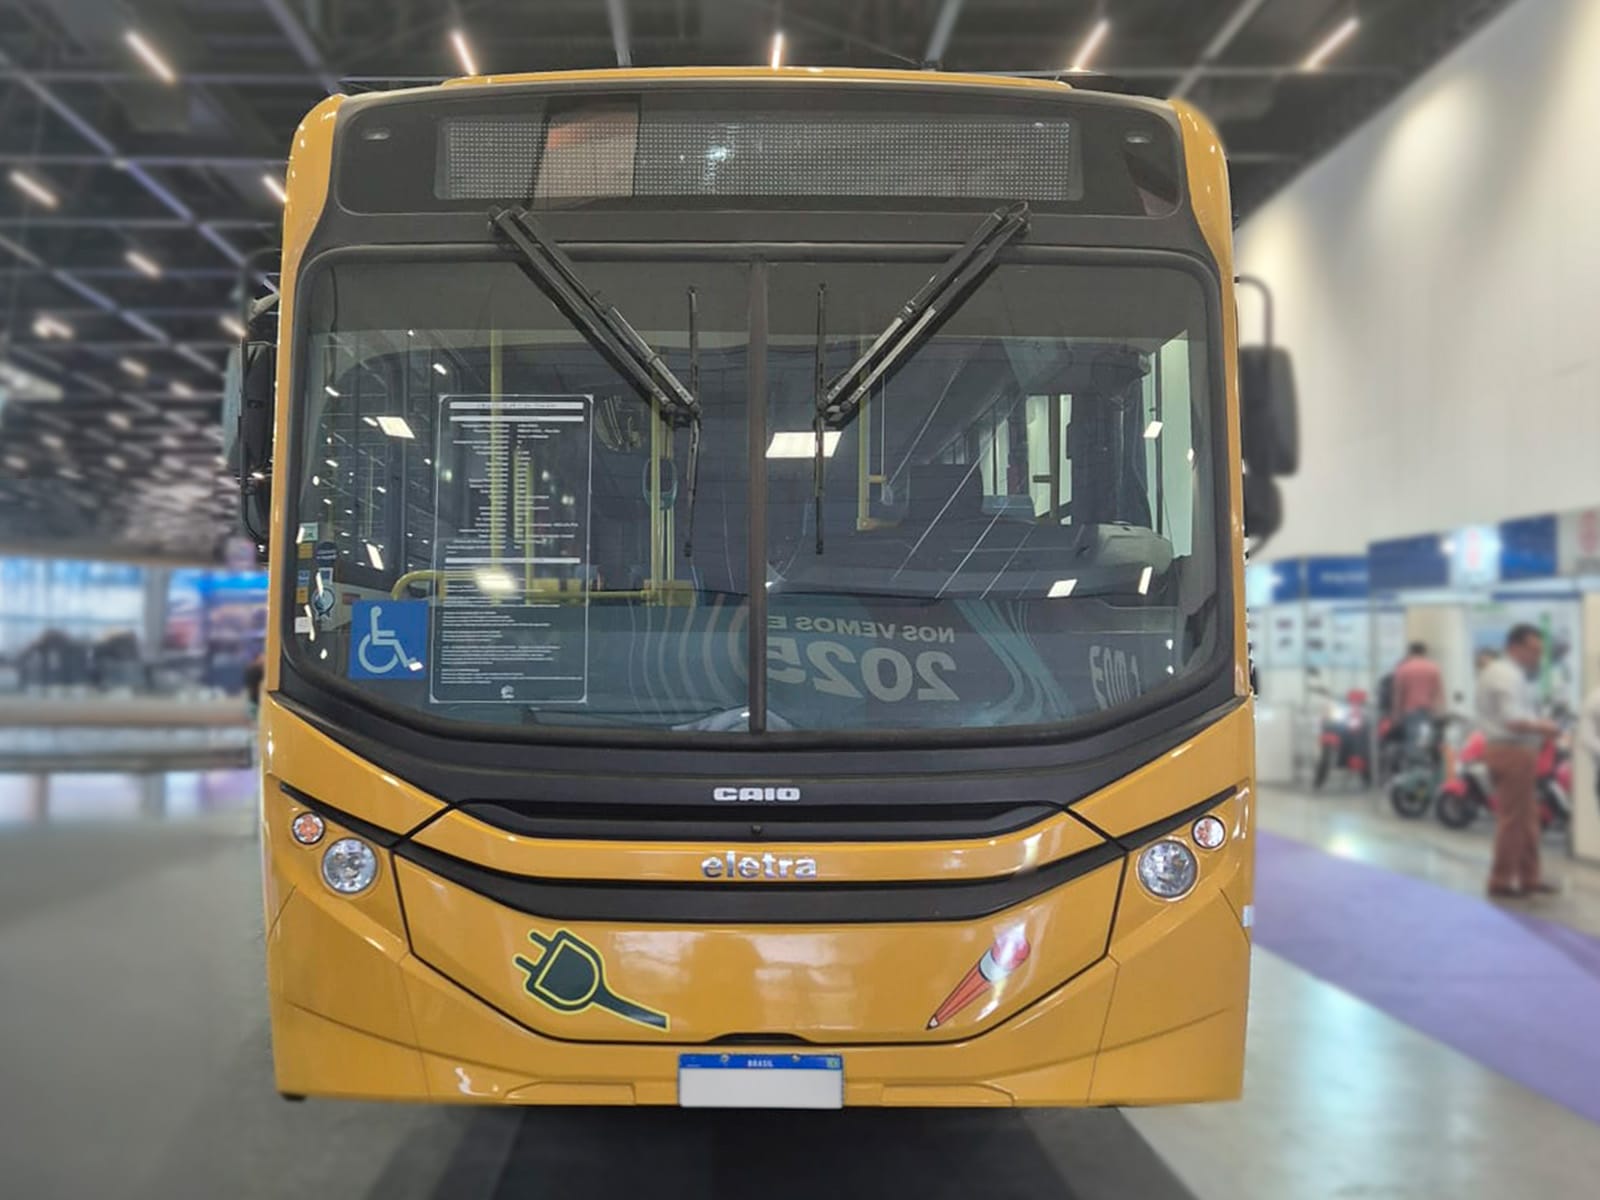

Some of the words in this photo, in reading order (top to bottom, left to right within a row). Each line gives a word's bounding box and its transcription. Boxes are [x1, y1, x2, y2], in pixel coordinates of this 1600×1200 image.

[713, 787, 801, 801] CAIO
[701, 850, 817, 878] eletra
[747, 1059, 774, 1068] BRASIL
